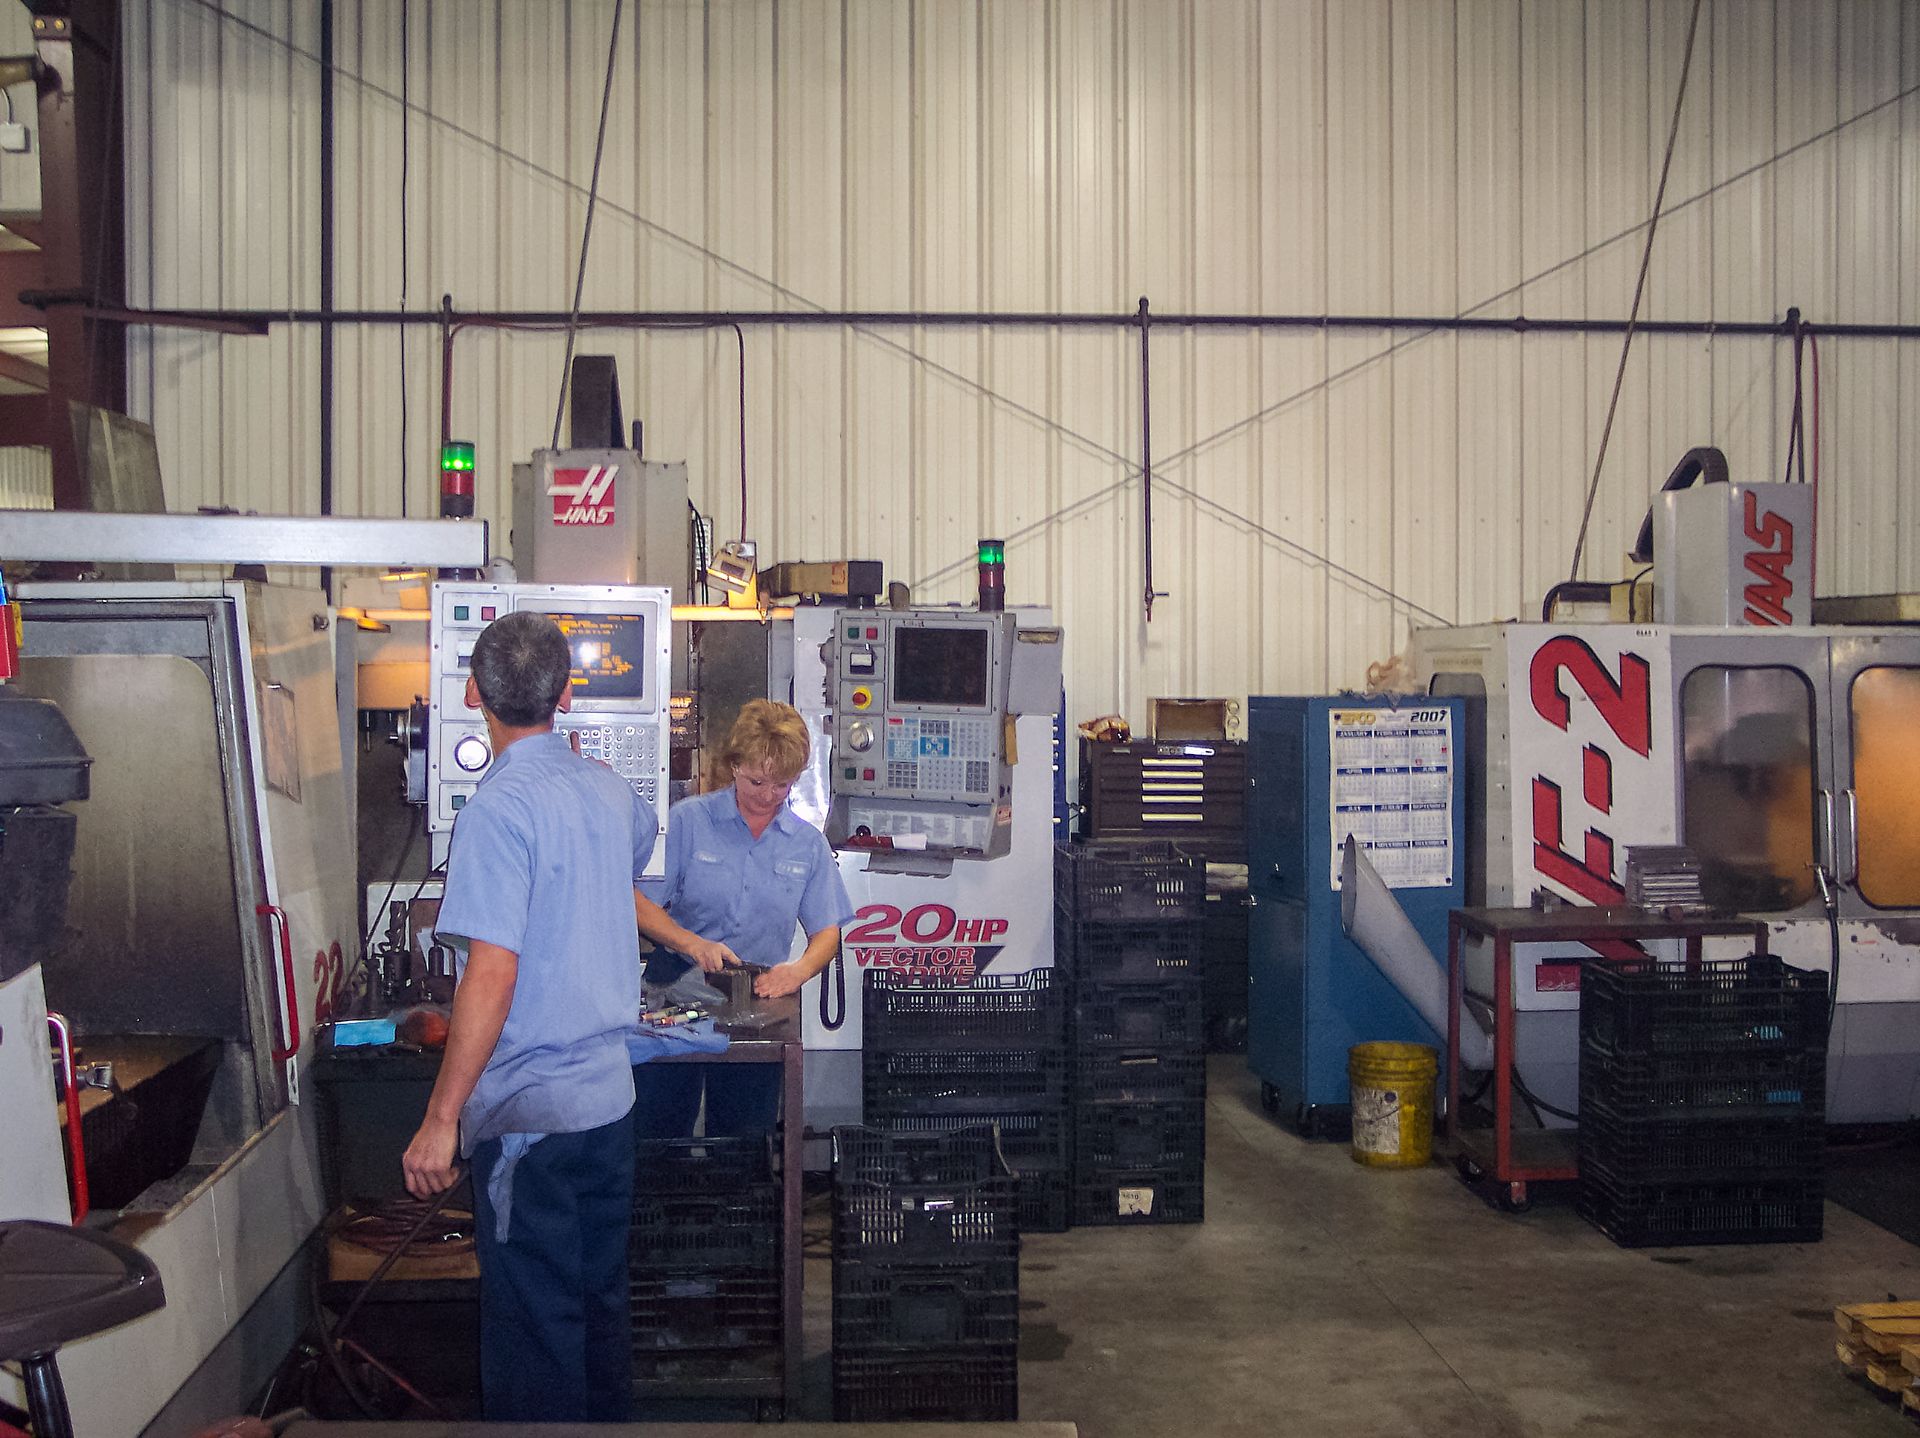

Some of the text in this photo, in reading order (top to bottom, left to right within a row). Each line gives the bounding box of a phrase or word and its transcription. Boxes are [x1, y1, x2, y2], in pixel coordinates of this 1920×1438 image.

[553, 506, 615, 524] HAAS
[1411, 711, 1447, 723] 2007
[855, 947, 976, 967] VECTOR
[313, 939, 344, 1023] 22
